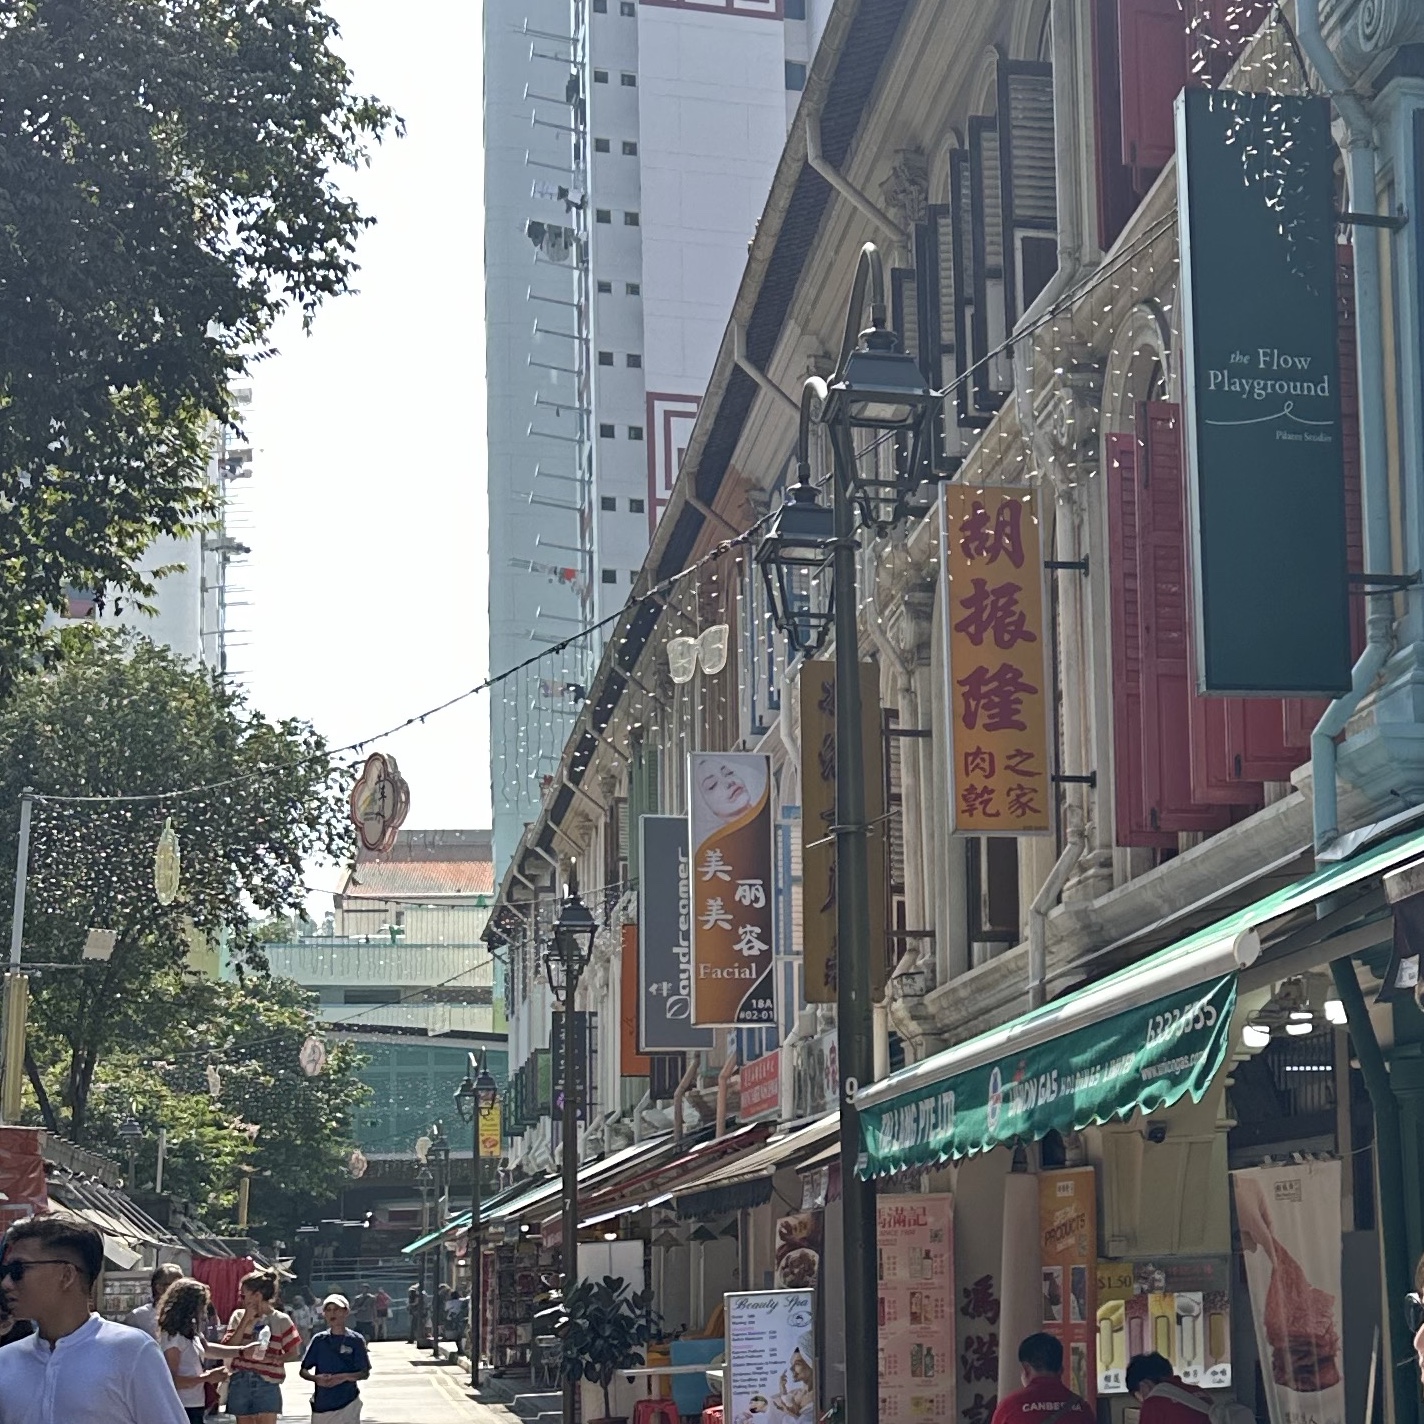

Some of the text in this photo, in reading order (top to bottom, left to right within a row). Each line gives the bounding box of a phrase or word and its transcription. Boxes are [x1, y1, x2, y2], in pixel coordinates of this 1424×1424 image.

[1229, 348, 1311, 370] the Flow
[1208, 369, 1329, 400] Playground
[953, 499, 1039, 733] 胡振隆
[1003, 748, 1044, 818] 之家
[699, 962, 758, 979] Facial
[845, 1076, 858, 1104] 9
[1008, 1078, 1038, 1117] UNION
[1037, 1068, 1059, 1105] GAS
[564, 1198, 571, 1211] 7
[1097, 1275, 1132, 1290] $1.50
[732, 1295, 809, 1315] Beauty Spa
